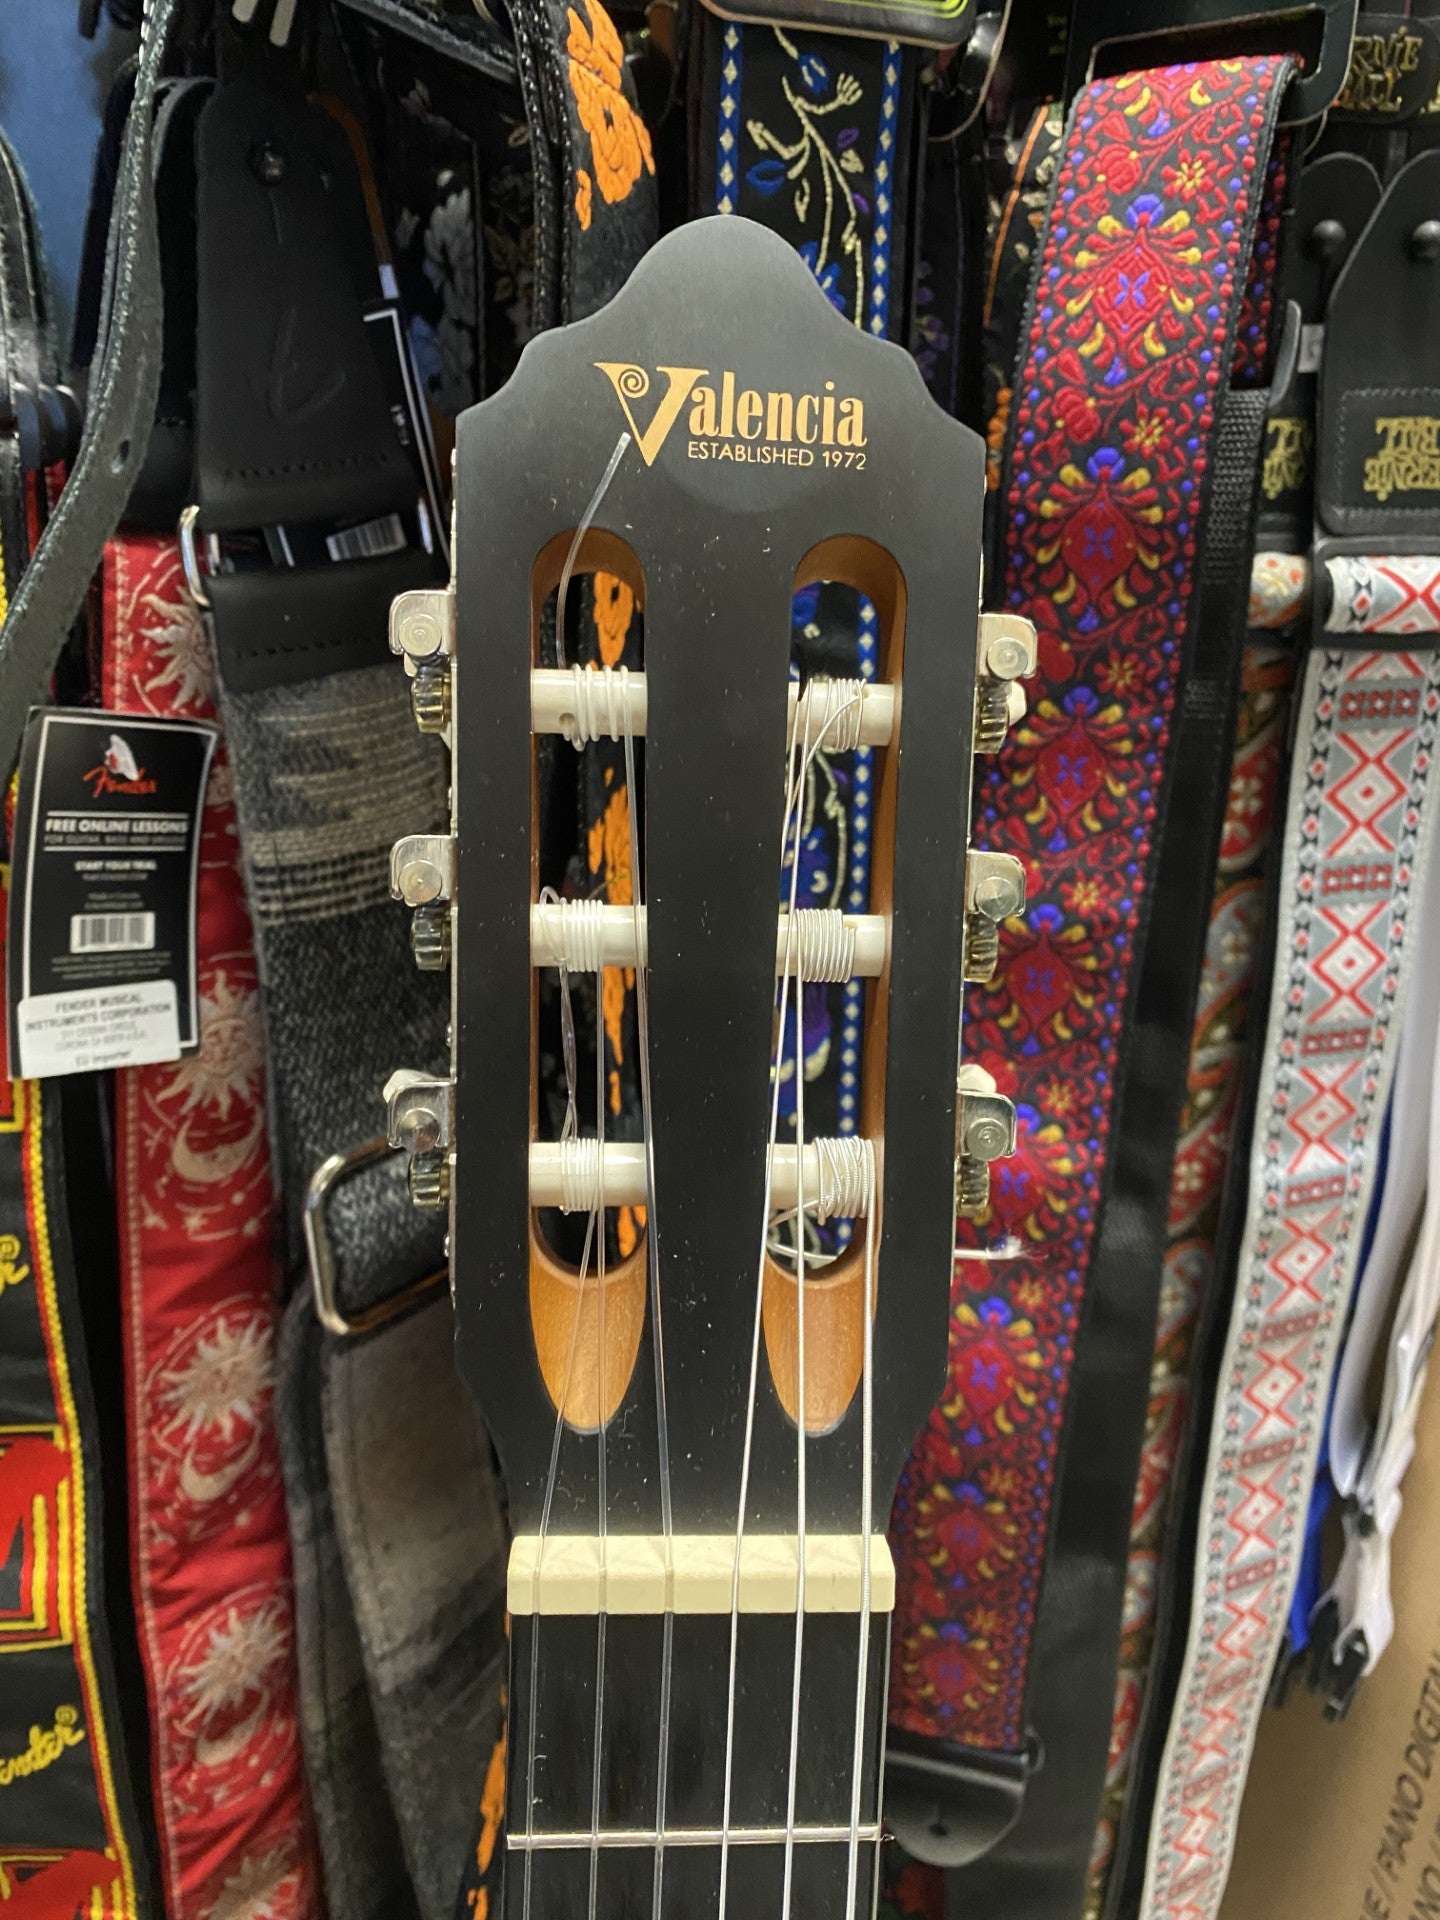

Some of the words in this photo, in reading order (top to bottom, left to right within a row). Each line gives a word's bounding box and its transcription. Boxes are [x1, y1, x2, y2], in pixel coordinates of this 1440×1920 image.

[1350, 25, 1423, 71] RNIE
[593, 362, 867, 466] Valencia
[688, 441, 814, 467] ESTABLISHED
[822, 450, 867, 470] 1972
[45, 818, 77, 833] FREE
[78, 819, 130, 834] ONLINE
[132, 820, 189, 834] LESSONS
[25, 1013, 98, 1032] INSTRUMENTS
[101, 1003, 172, 1022] CORPORATION
[55, 997, 96, 1013] FENDER
[99, 994, 140, 1008] MUSICAL
